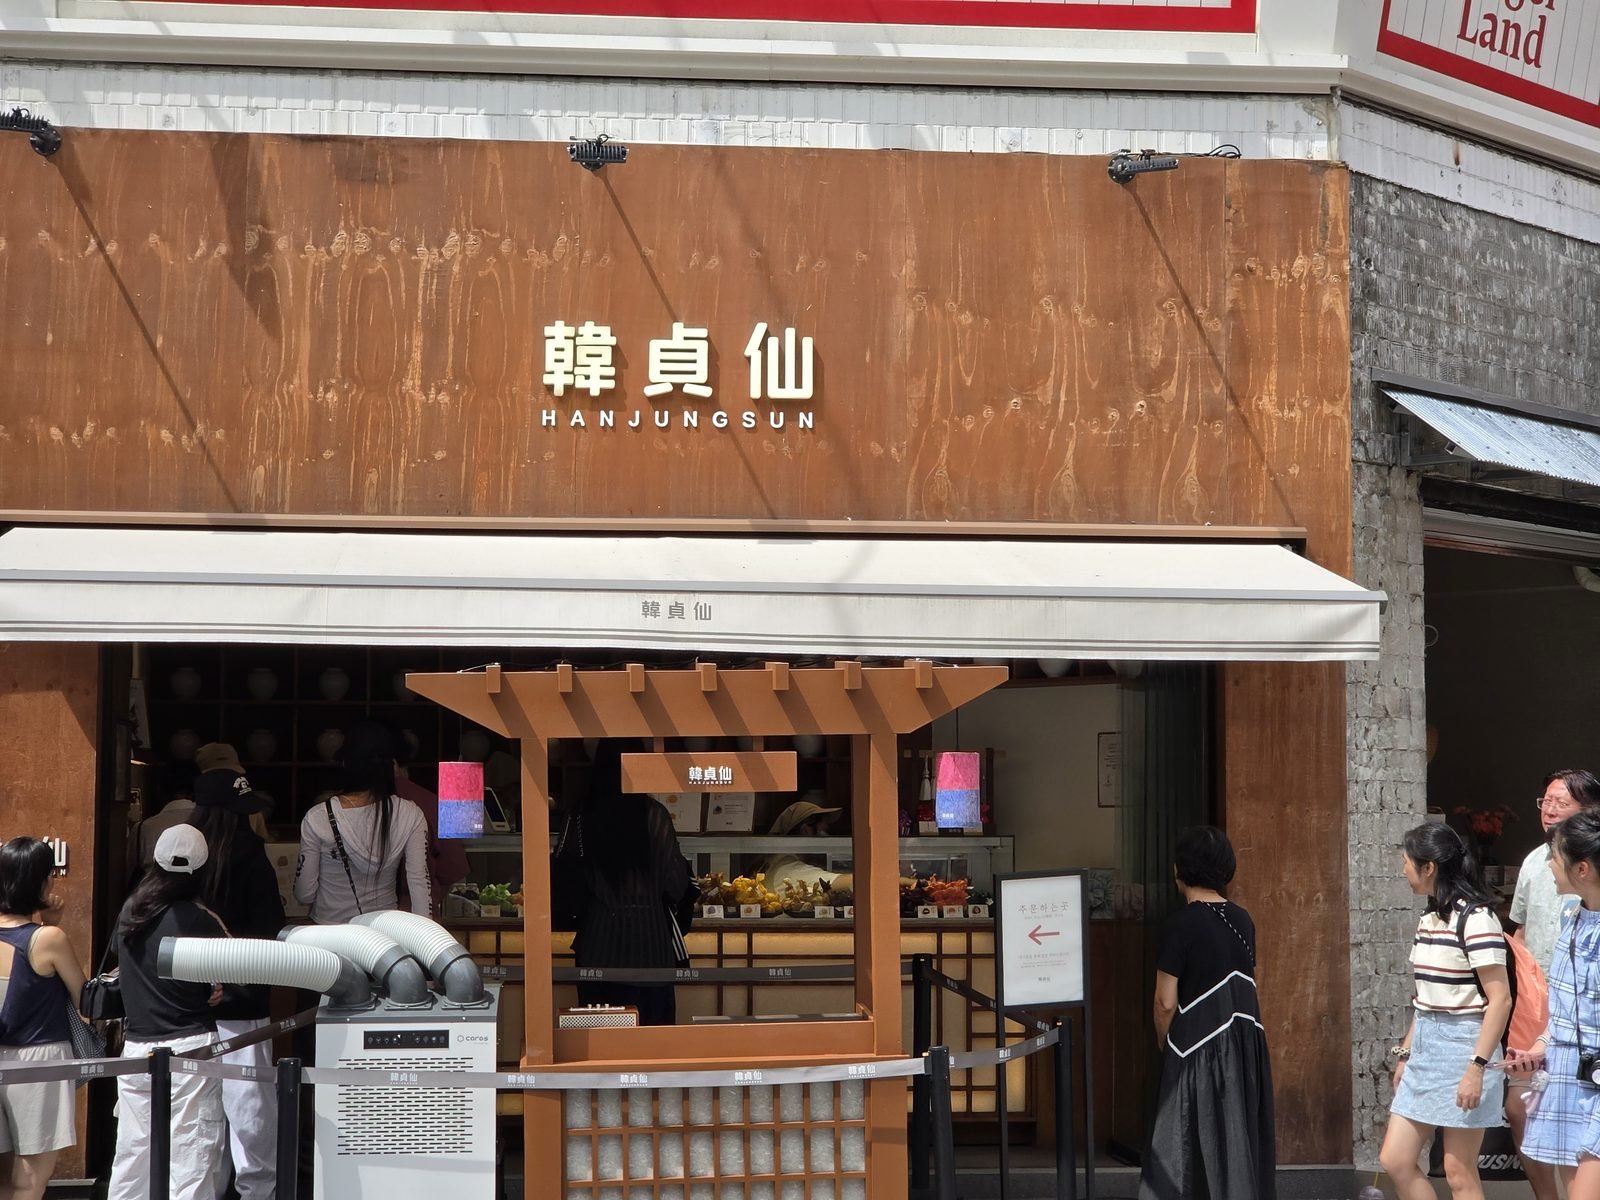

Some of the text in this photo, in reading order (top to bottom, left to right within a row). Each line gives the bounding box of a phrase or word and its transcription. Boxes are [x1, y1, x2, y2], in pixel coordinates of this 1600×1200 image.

[1457, 0, 1547, 68] Land
[543, 320, 814, 399] 韓貞仙
[541, 409, 814, 429] HANJUNGSUN
[641, 600, 712, 620] 韓貞仙
[689, 766, 732, 780] 韓貞仙
